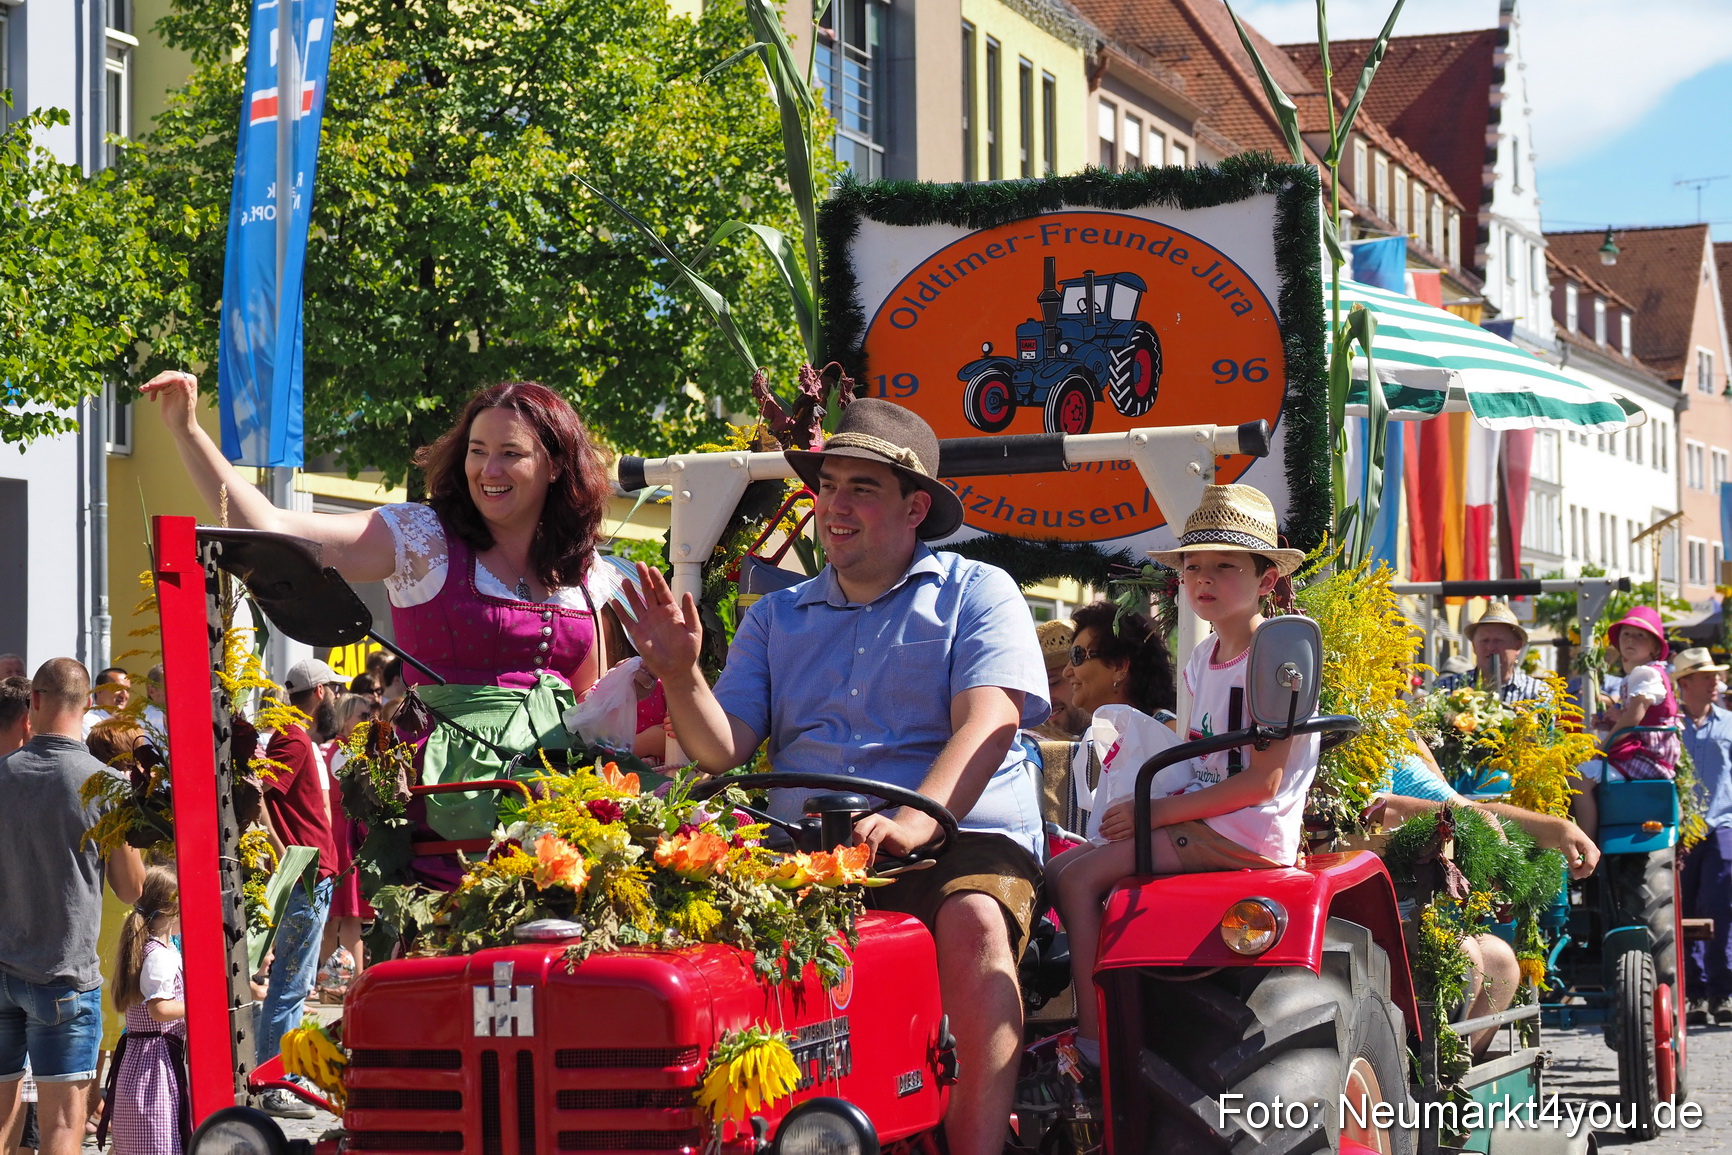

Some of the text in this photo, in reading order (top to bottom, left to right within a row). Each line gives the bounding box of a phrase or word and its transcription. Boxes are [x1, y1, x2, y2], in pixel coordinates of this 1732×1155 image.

[889, 222, 1254, 329] Oldtimer-Freunde Jura
[873, 357, 1269, 398] 19 96
[945, 478, 1150, 527] atzhausen/
